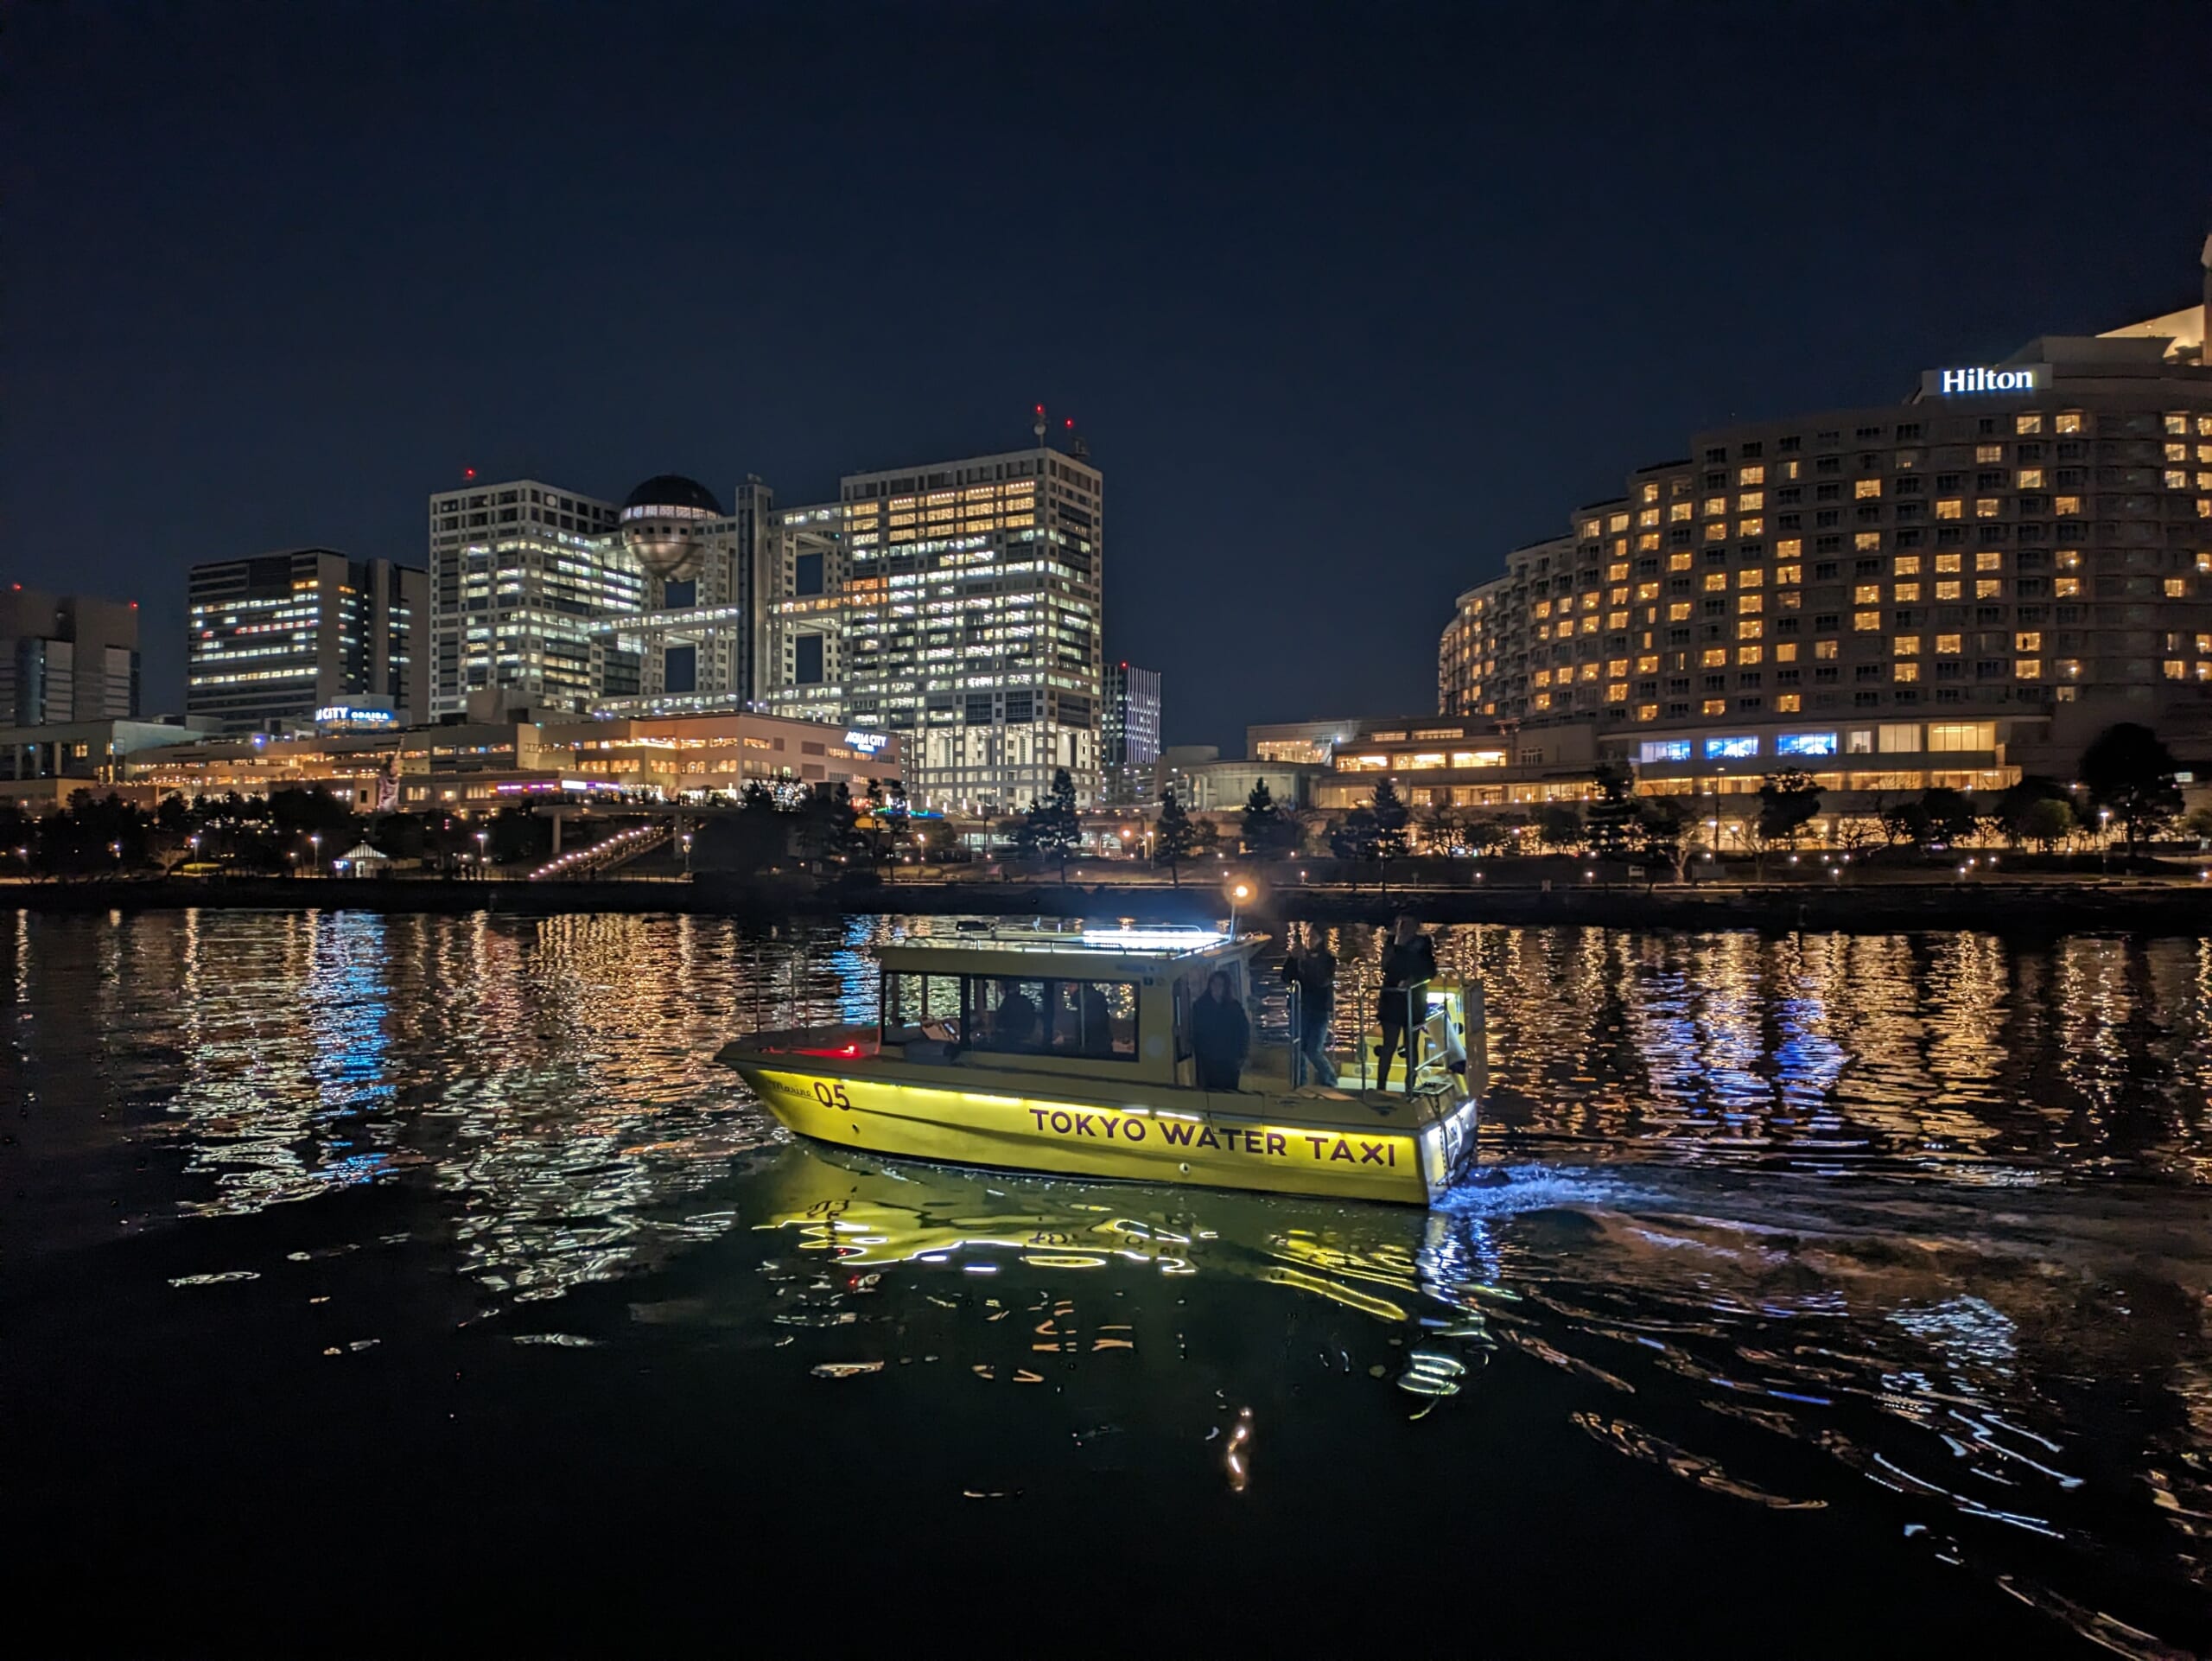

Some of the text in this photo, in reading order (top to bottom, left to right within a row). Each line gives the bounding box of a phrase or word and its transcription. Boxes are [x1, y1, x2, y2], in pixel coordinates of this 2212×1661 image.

[1942, 367, 2033, 392] Hilton
[322, 707, 349, 720] CITY
[869, 734, 887, 748] CITY
[814, 1081, 850, 1111] 05
[1029, 1109, 1395, 1167] TOKYO WATER TAXI
